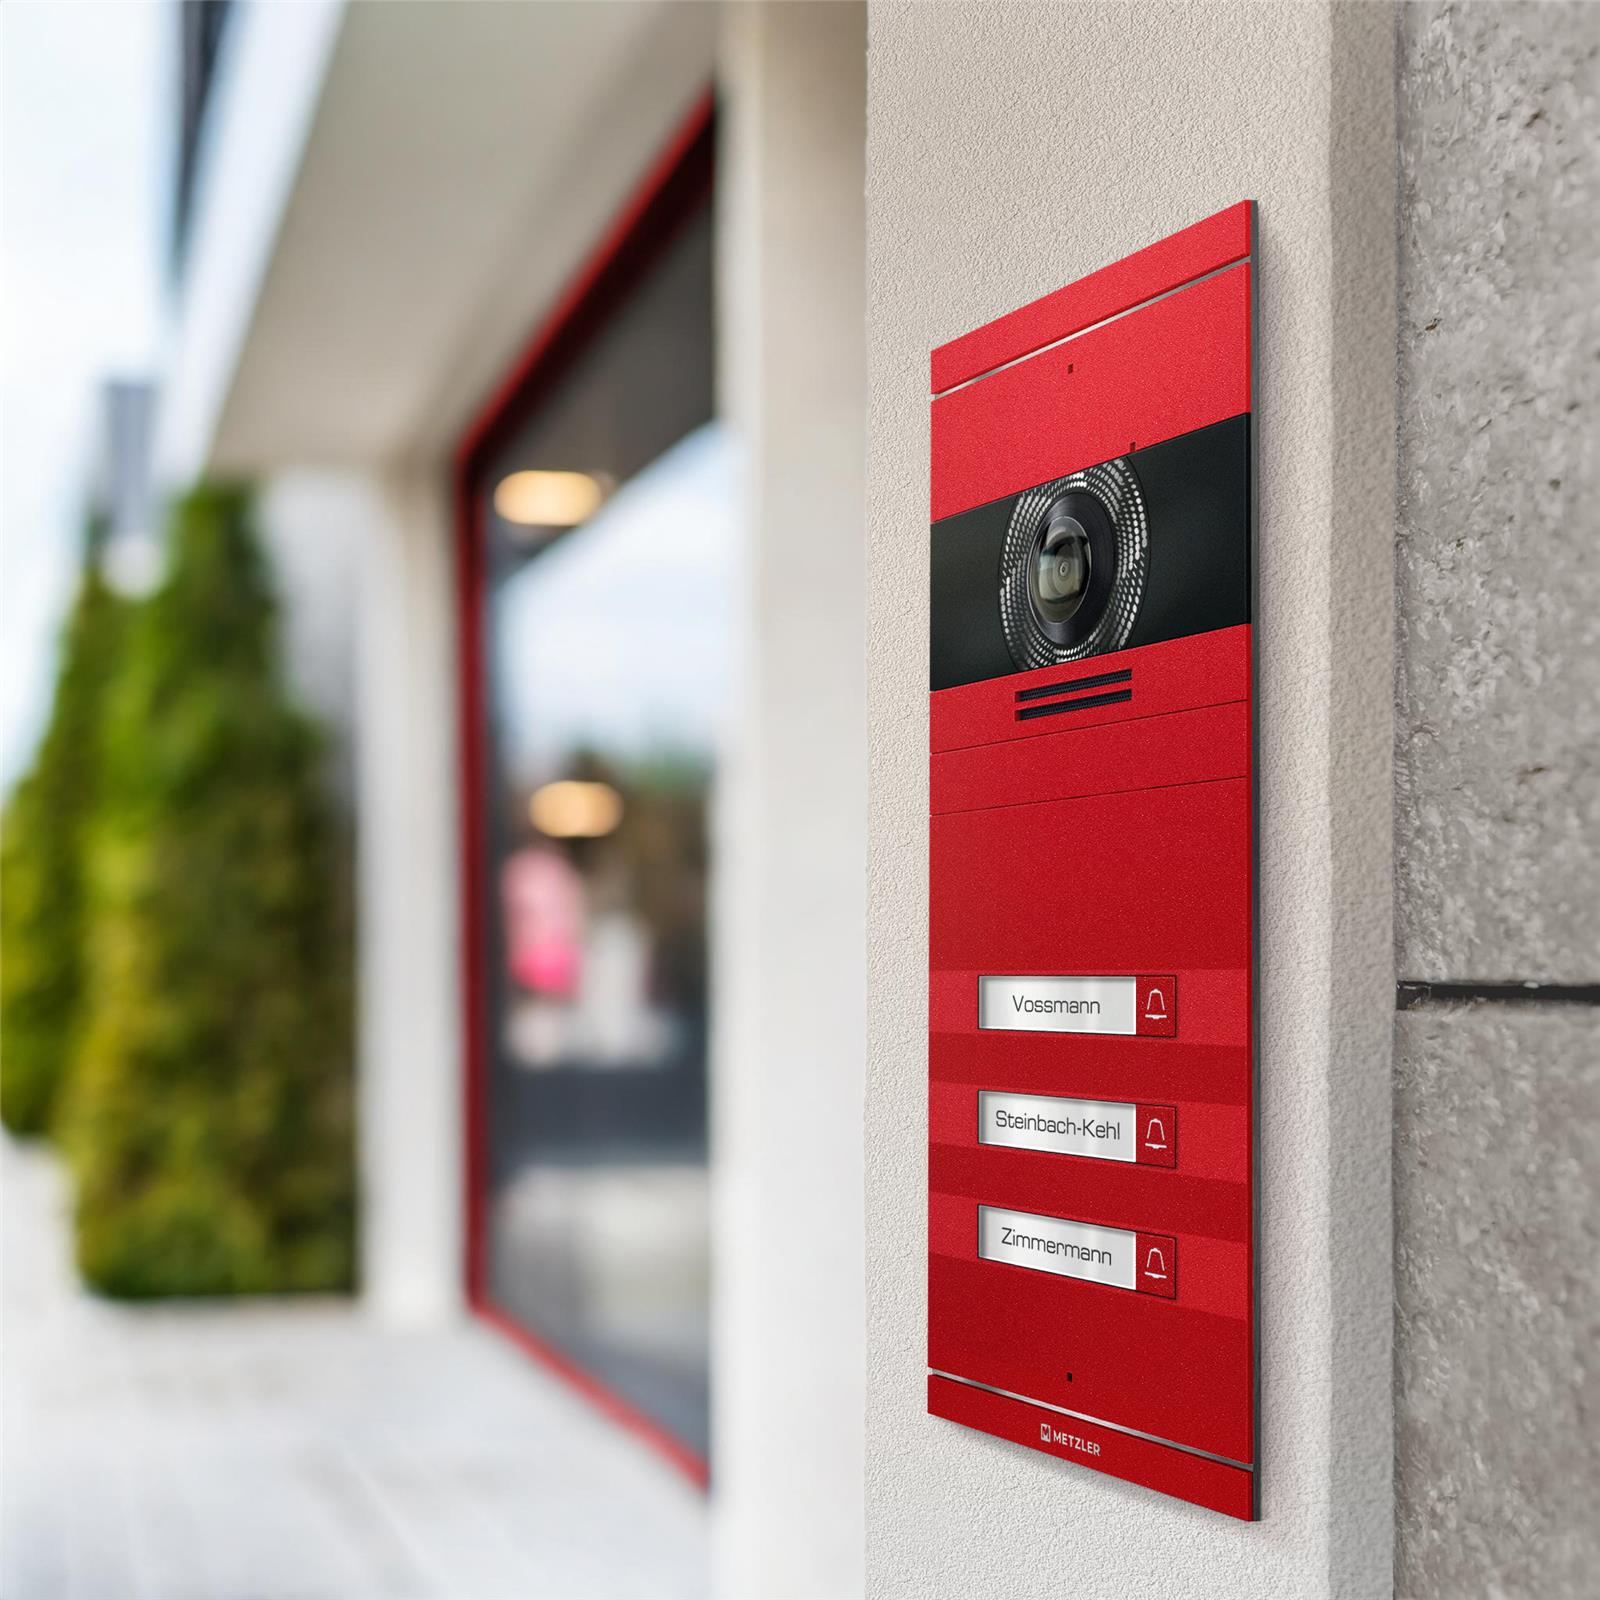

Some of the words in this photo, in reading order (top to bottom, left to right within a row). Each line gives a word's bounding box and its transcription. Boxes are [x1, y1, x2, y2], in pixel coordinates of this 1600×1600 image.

[1012, 995, 1101, 1014] Vossmann
[995, 1110, 1120, 1140] Steinbach-Kehl
[1001, 1227, 1112, 1266] Zimmermann
[1053, 1430, 1101, 1457] METZLER
